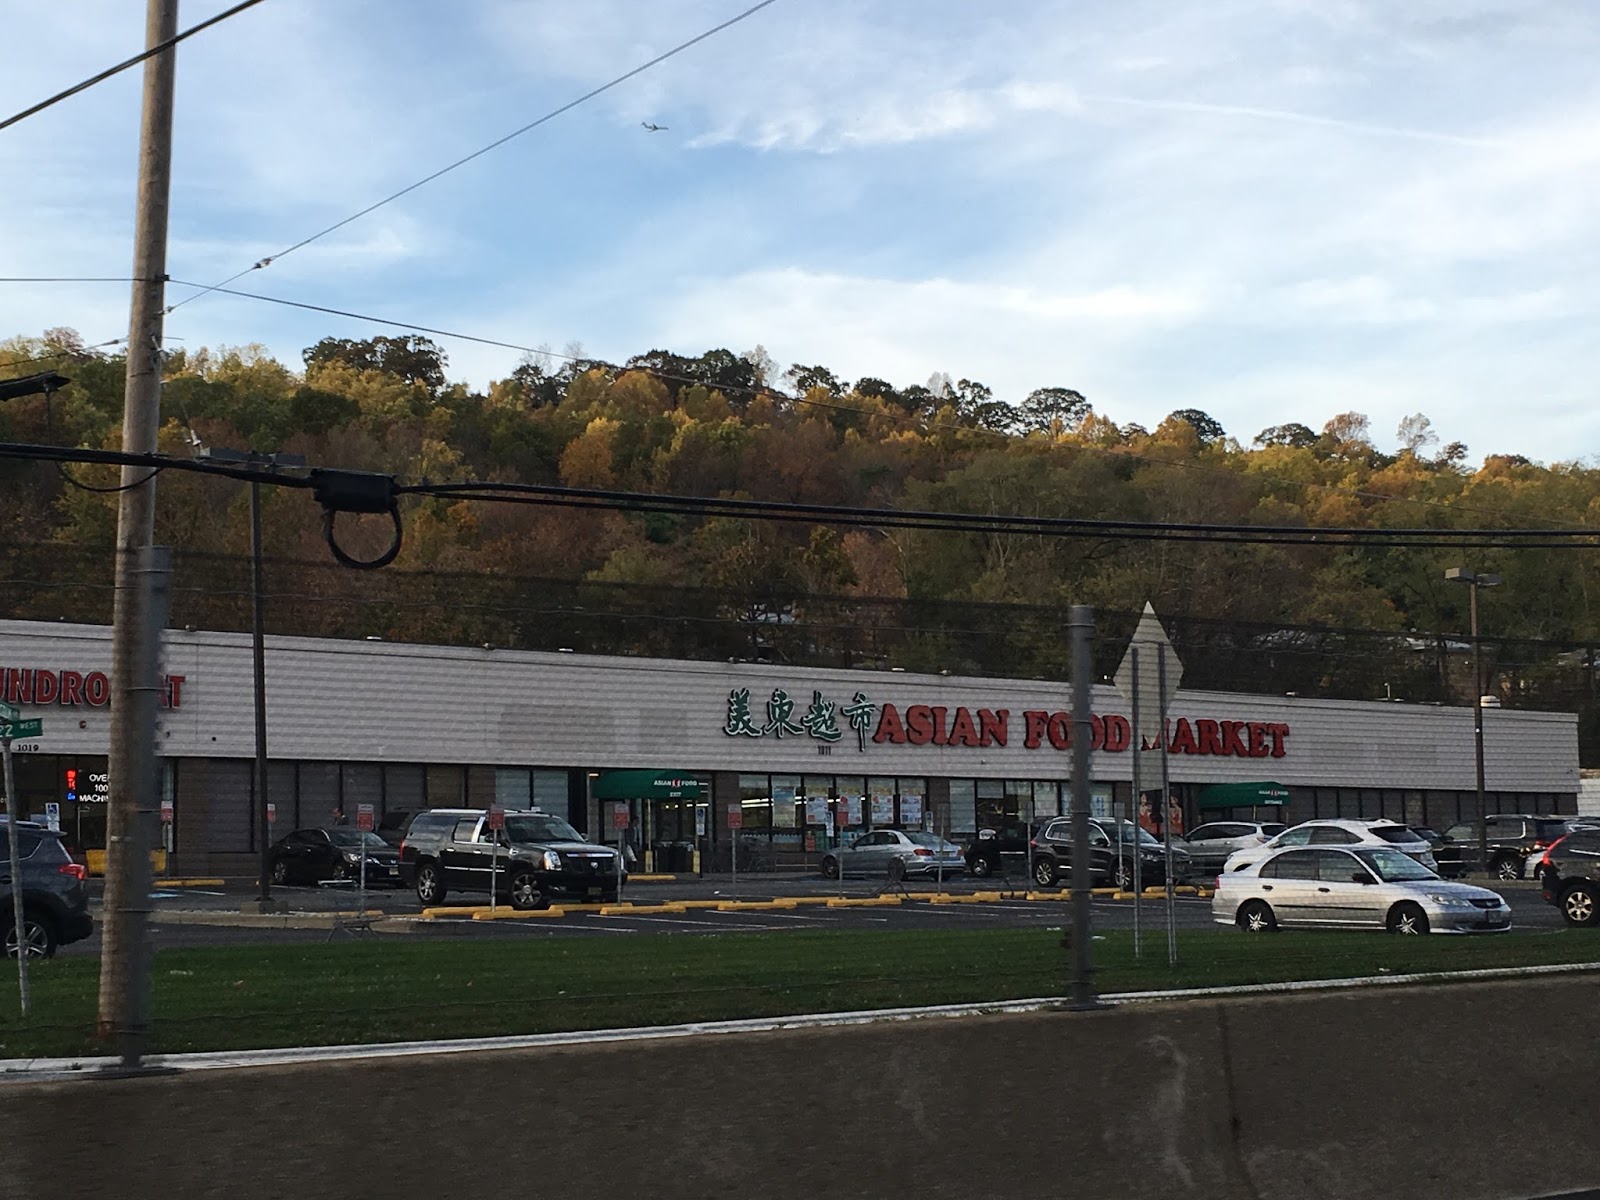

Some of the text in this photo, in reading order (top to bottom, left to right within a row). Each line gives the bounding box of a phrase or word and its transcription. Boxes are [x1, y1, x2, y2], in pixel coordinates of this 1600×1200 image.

[19, 721, 38, 729] WEST
[873, 703, 1009, 747] ASIAN
[1141, 717, 1289, 758] ARKET
[18, 744, 39, 752] 1019
[89, 774, 110, 782] OVE
